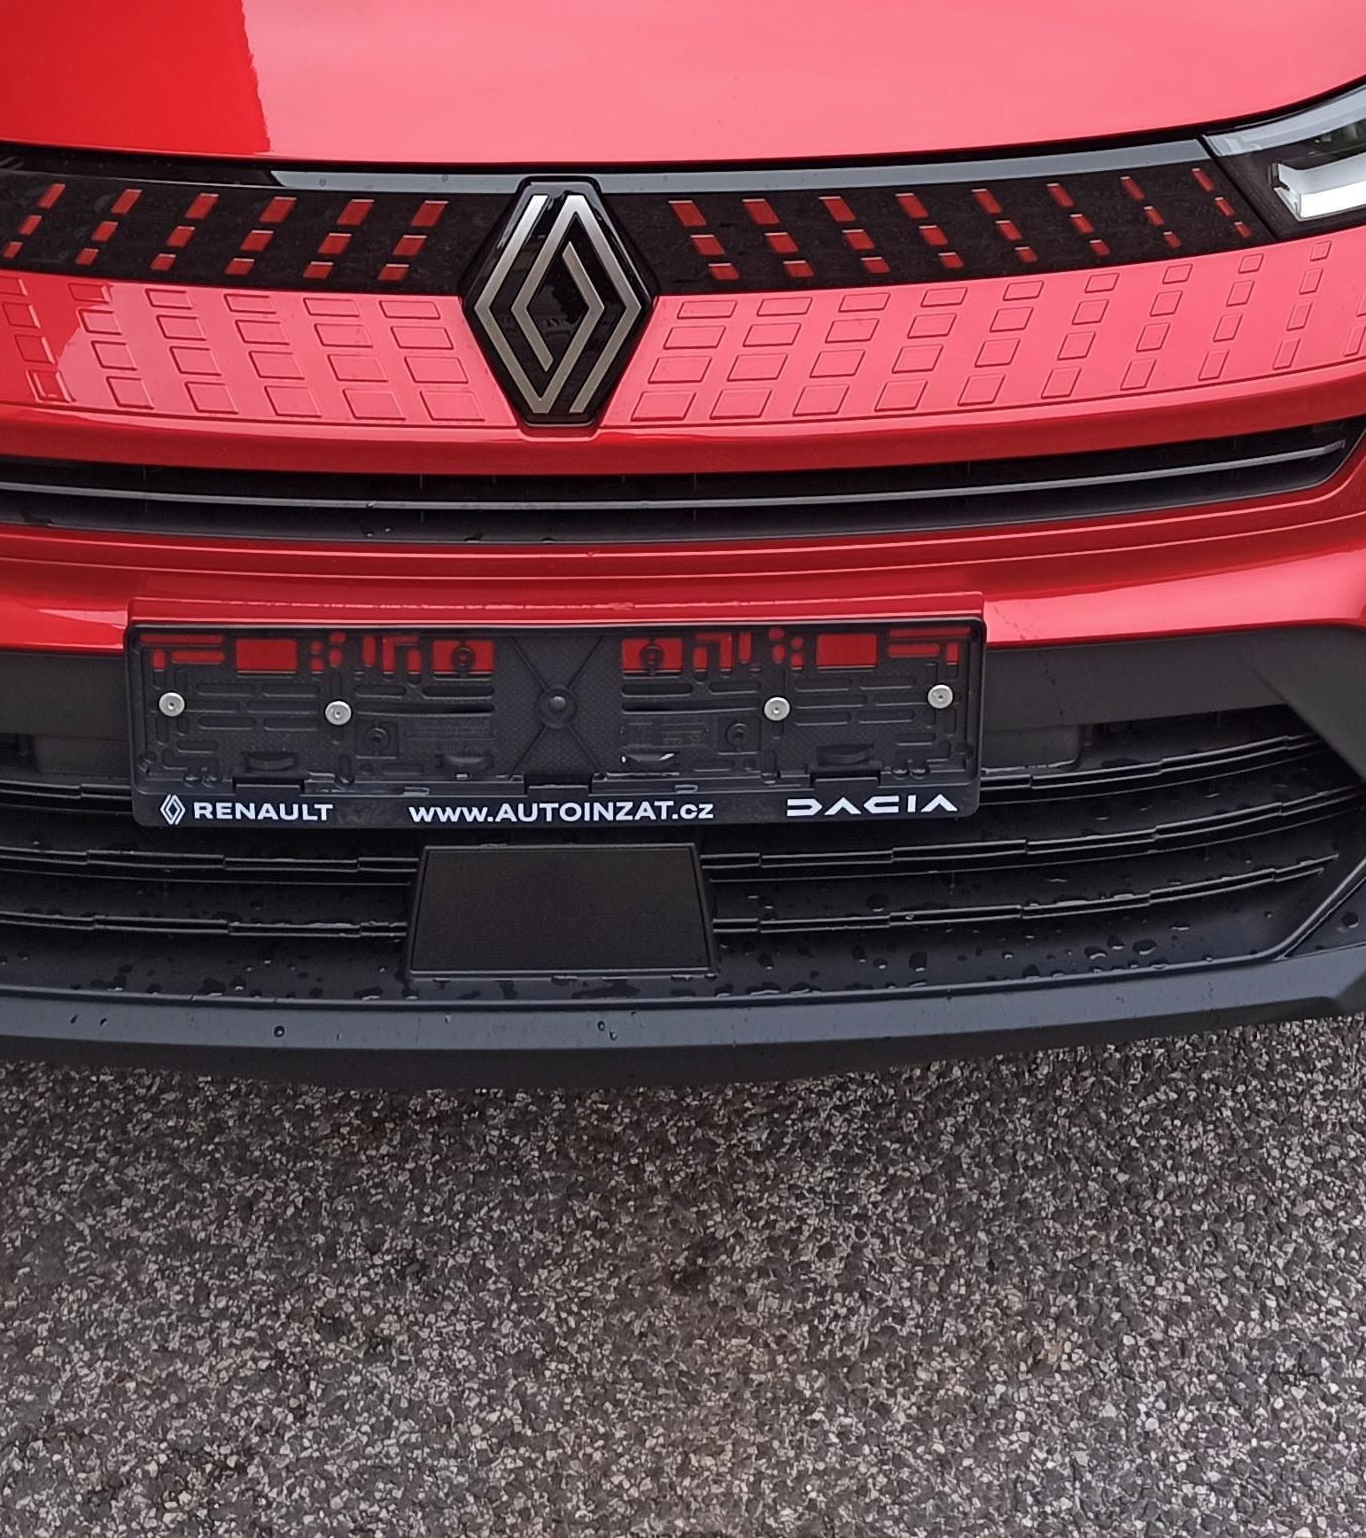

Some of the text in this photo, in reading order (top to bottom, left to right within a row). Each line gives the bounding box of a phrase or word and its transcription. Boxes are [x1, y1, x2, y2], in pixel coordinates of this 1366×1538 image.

[193, 801, 334, 822] RENAULT
[408, 800, 714, 823] www.AUTOINZAT.cz
[786, 793, 959, 817] DACIA
